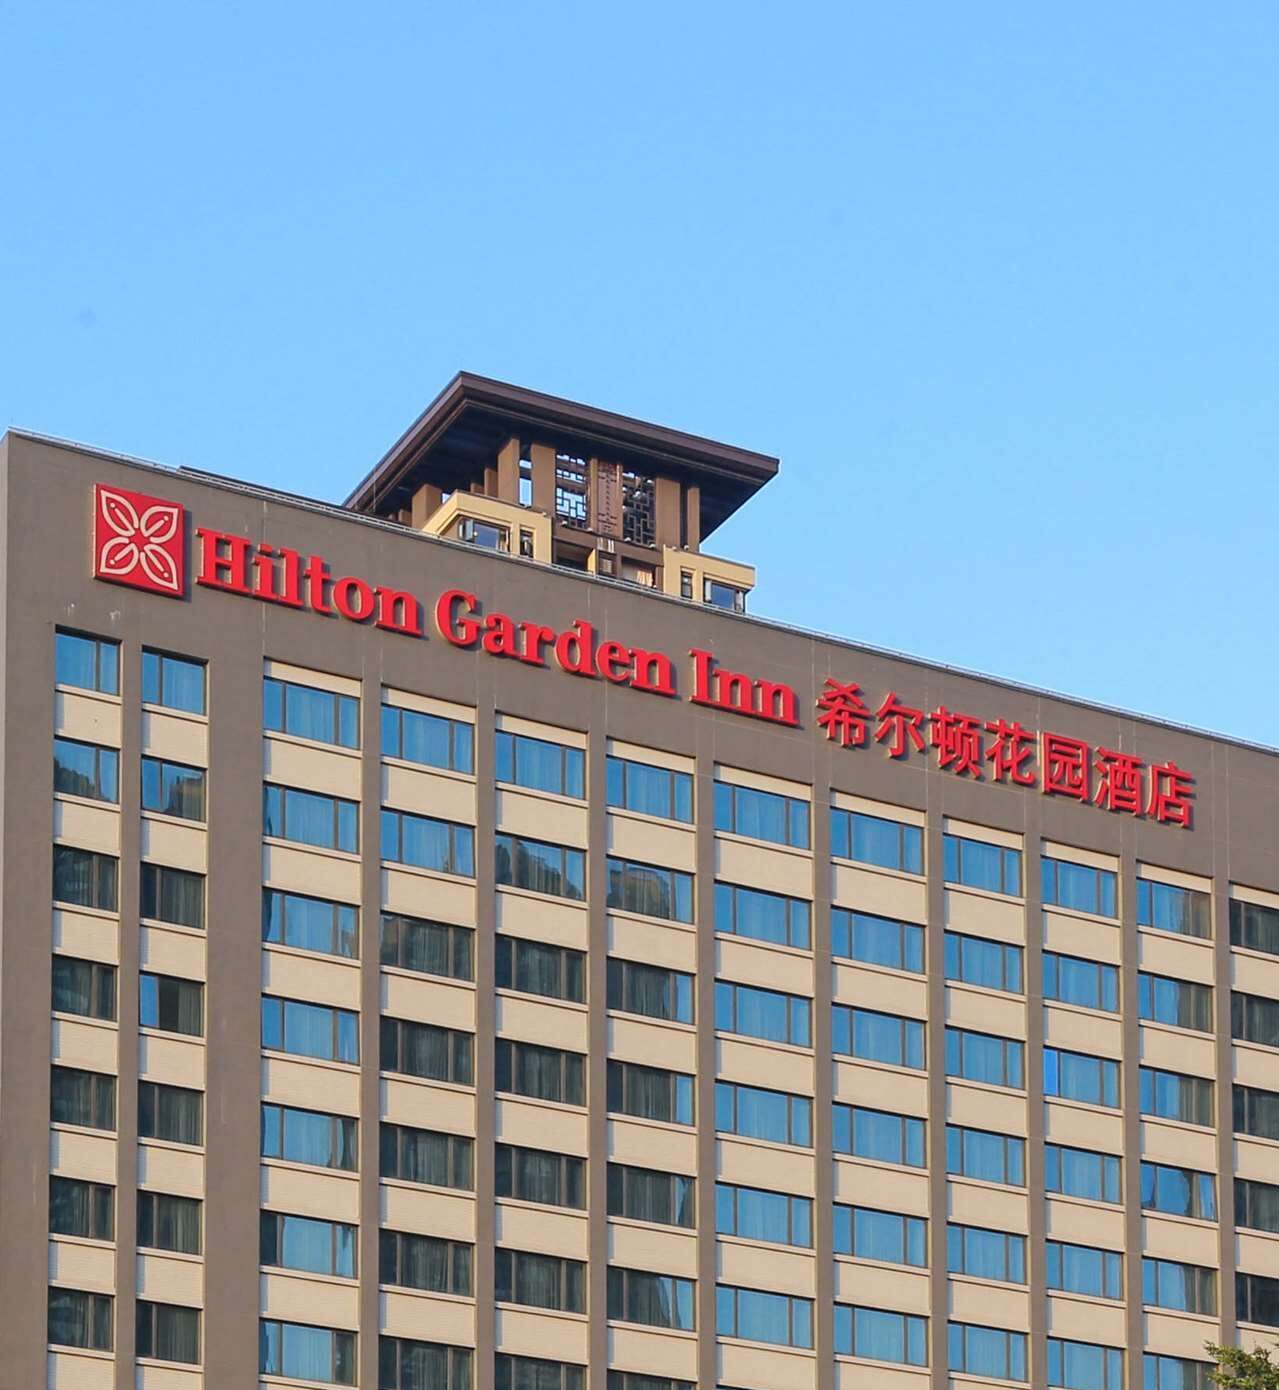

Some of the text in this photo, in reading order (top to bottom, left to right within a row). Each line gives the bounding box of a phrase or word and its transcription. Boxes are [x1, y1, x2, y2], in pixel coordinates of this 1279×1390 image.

[196, 526, 800, 728] Hilton Garden Inn
[816, 677, 1194, 828] 希尔顿花园酒店
